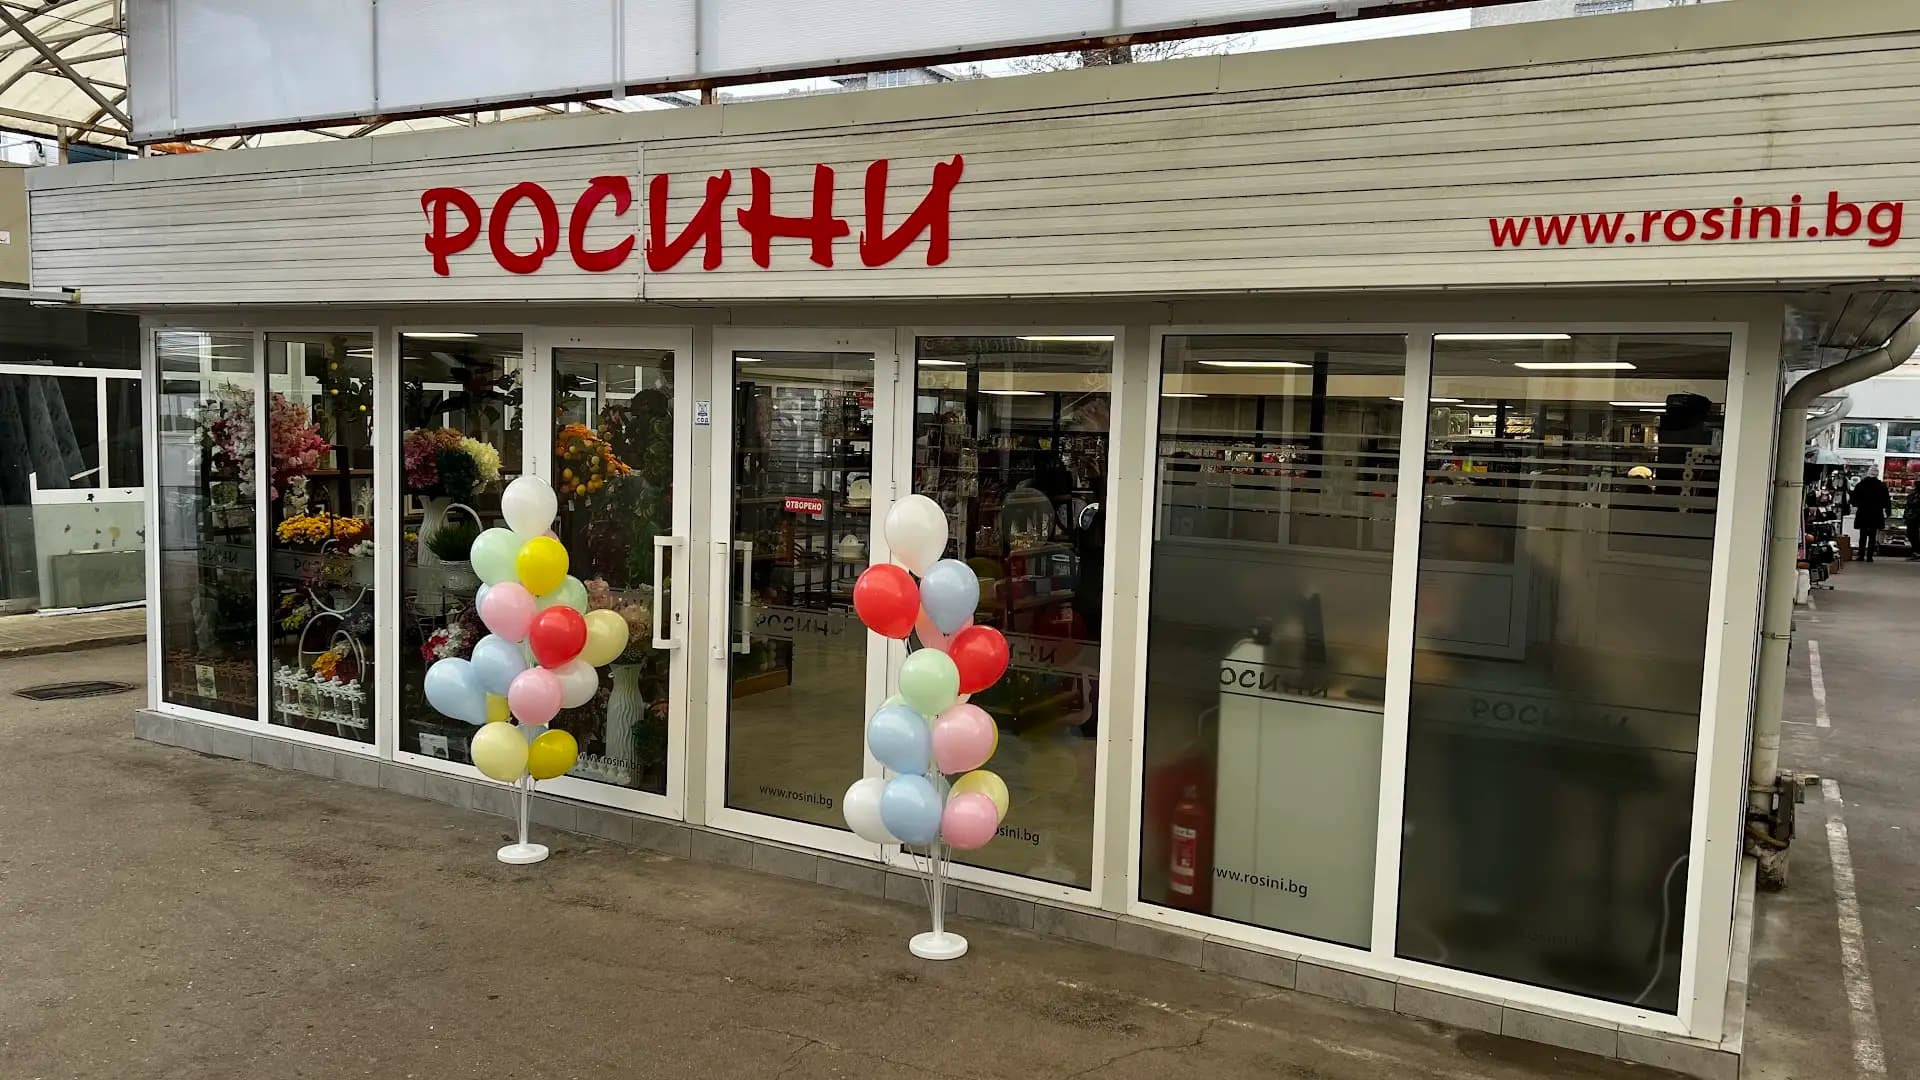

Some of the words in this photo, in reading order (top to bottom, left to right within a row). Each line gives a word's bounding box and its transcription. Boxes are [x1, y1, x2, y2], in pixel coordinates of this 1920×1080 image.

[421, 154, 964, 276] РОСИНИ
[1489, 191, 1904, 247] www.rosini.bg
[785, 500, 822, 512] ОТВОРЕНО
[759, 785, 833, 808] www.rosini.bg
